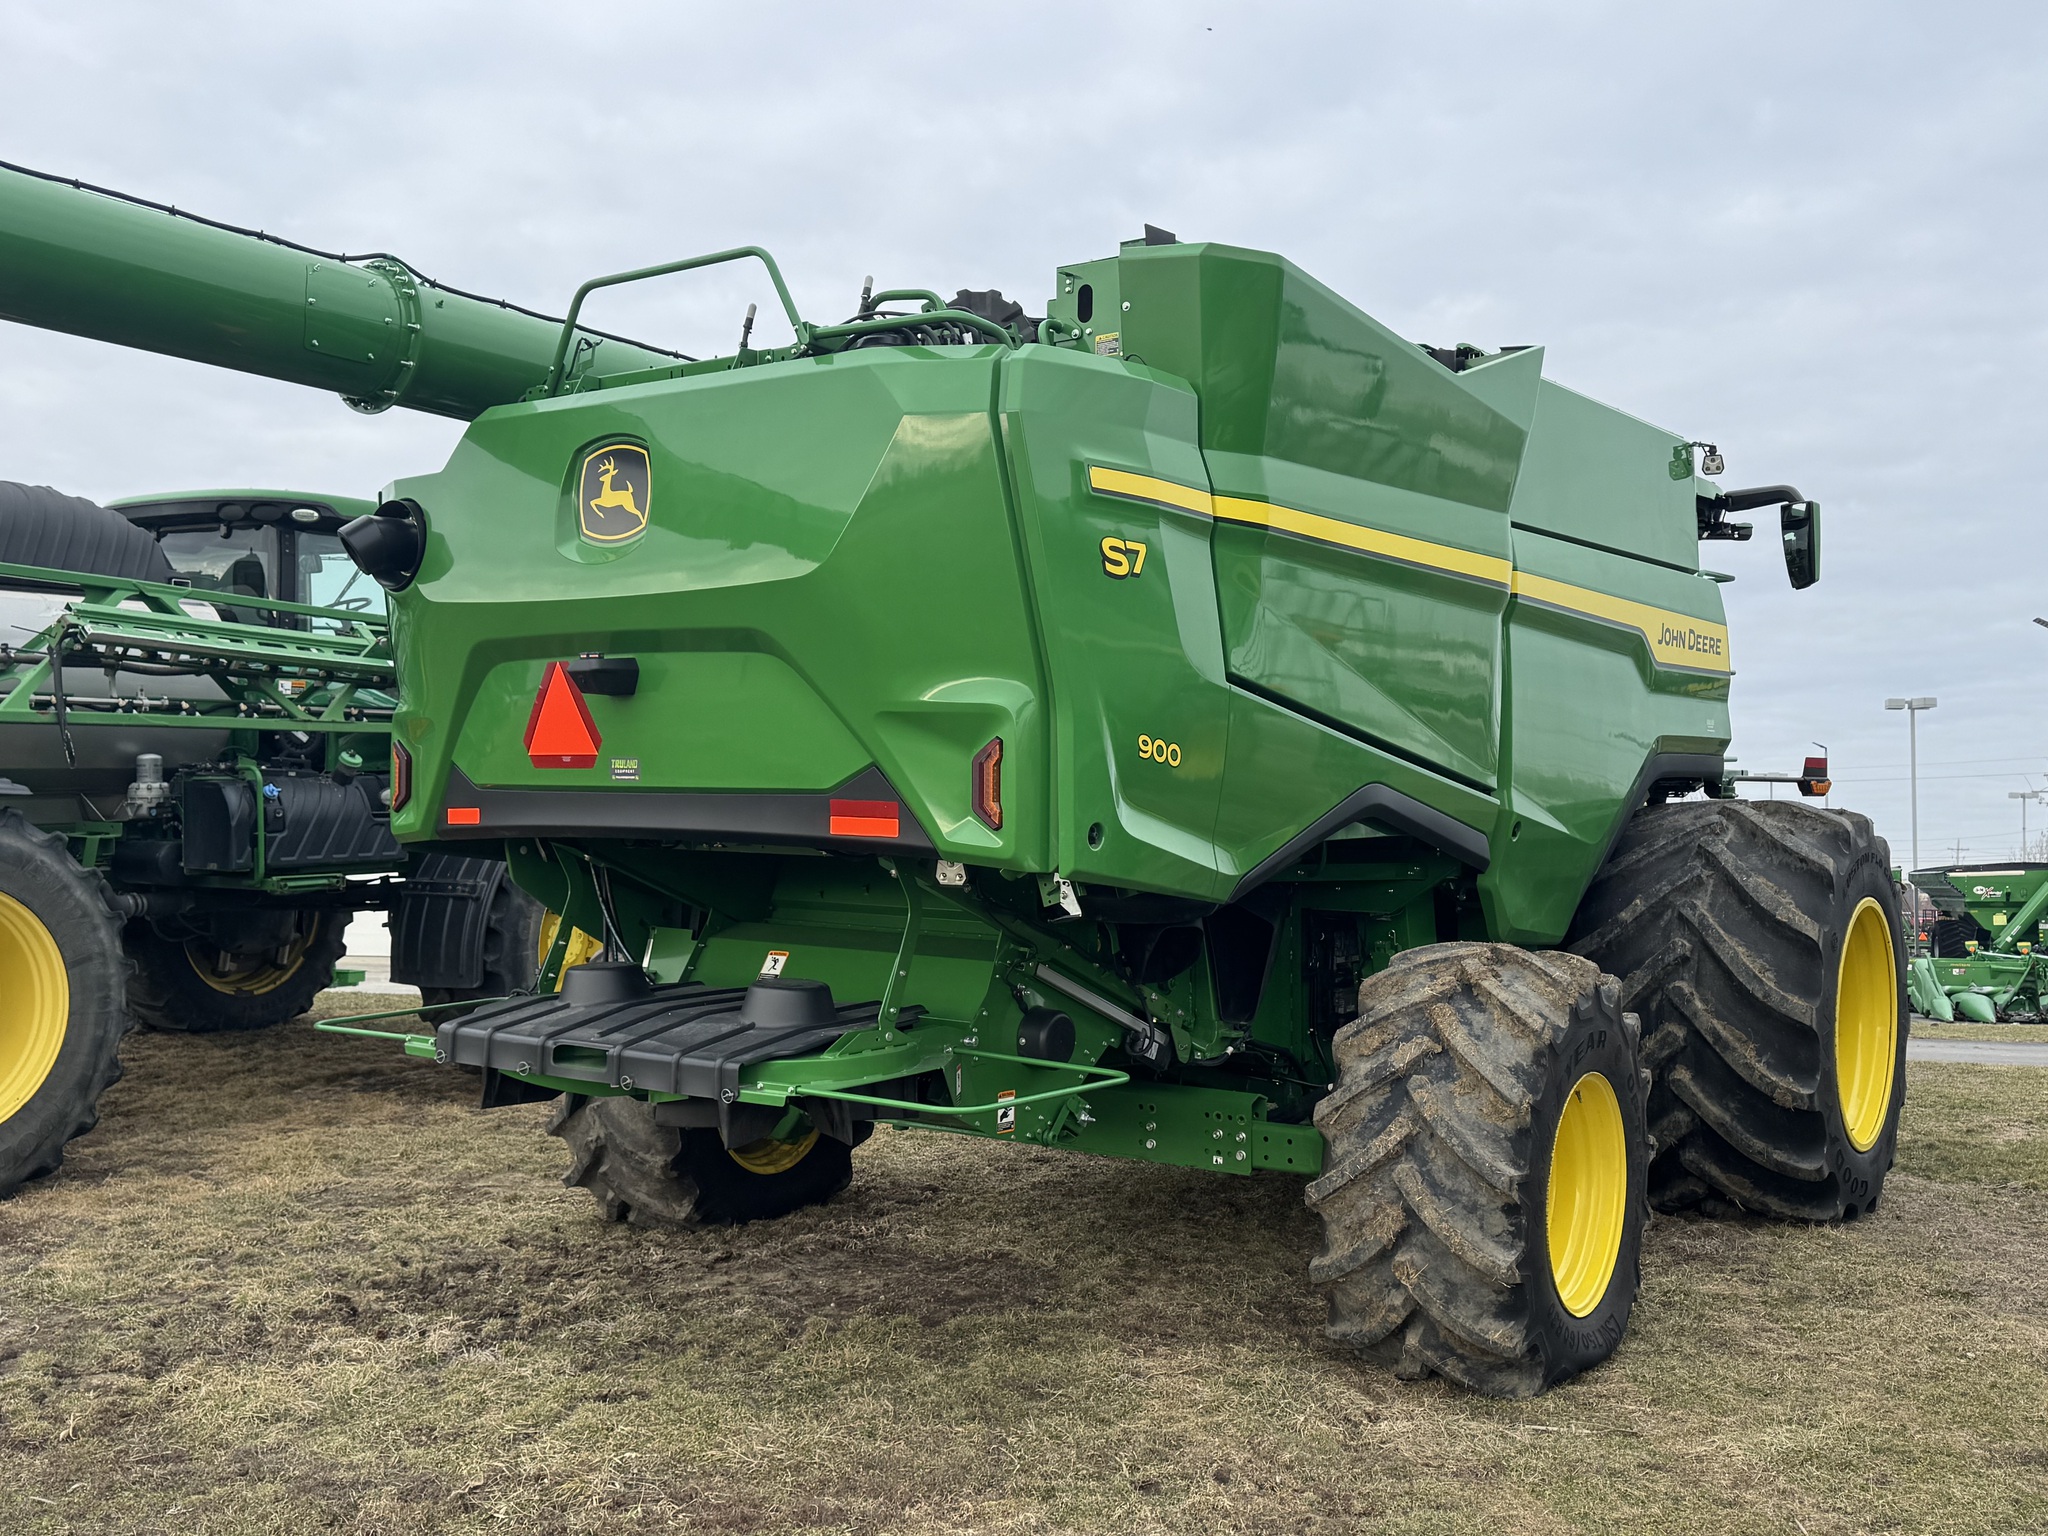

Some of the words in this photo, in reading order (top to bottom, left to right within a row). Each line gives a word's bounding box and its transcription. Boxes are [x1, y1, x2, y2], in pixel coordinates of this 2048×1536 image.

[1100, 536, 1147, 579] S7
[1658, 622, 1686, 649] JOHN
[1687, 628, 1722, 656] DEERE
[611, 759, 638, 769] TRULAND
[1138, 733, 1182, 768] 900
